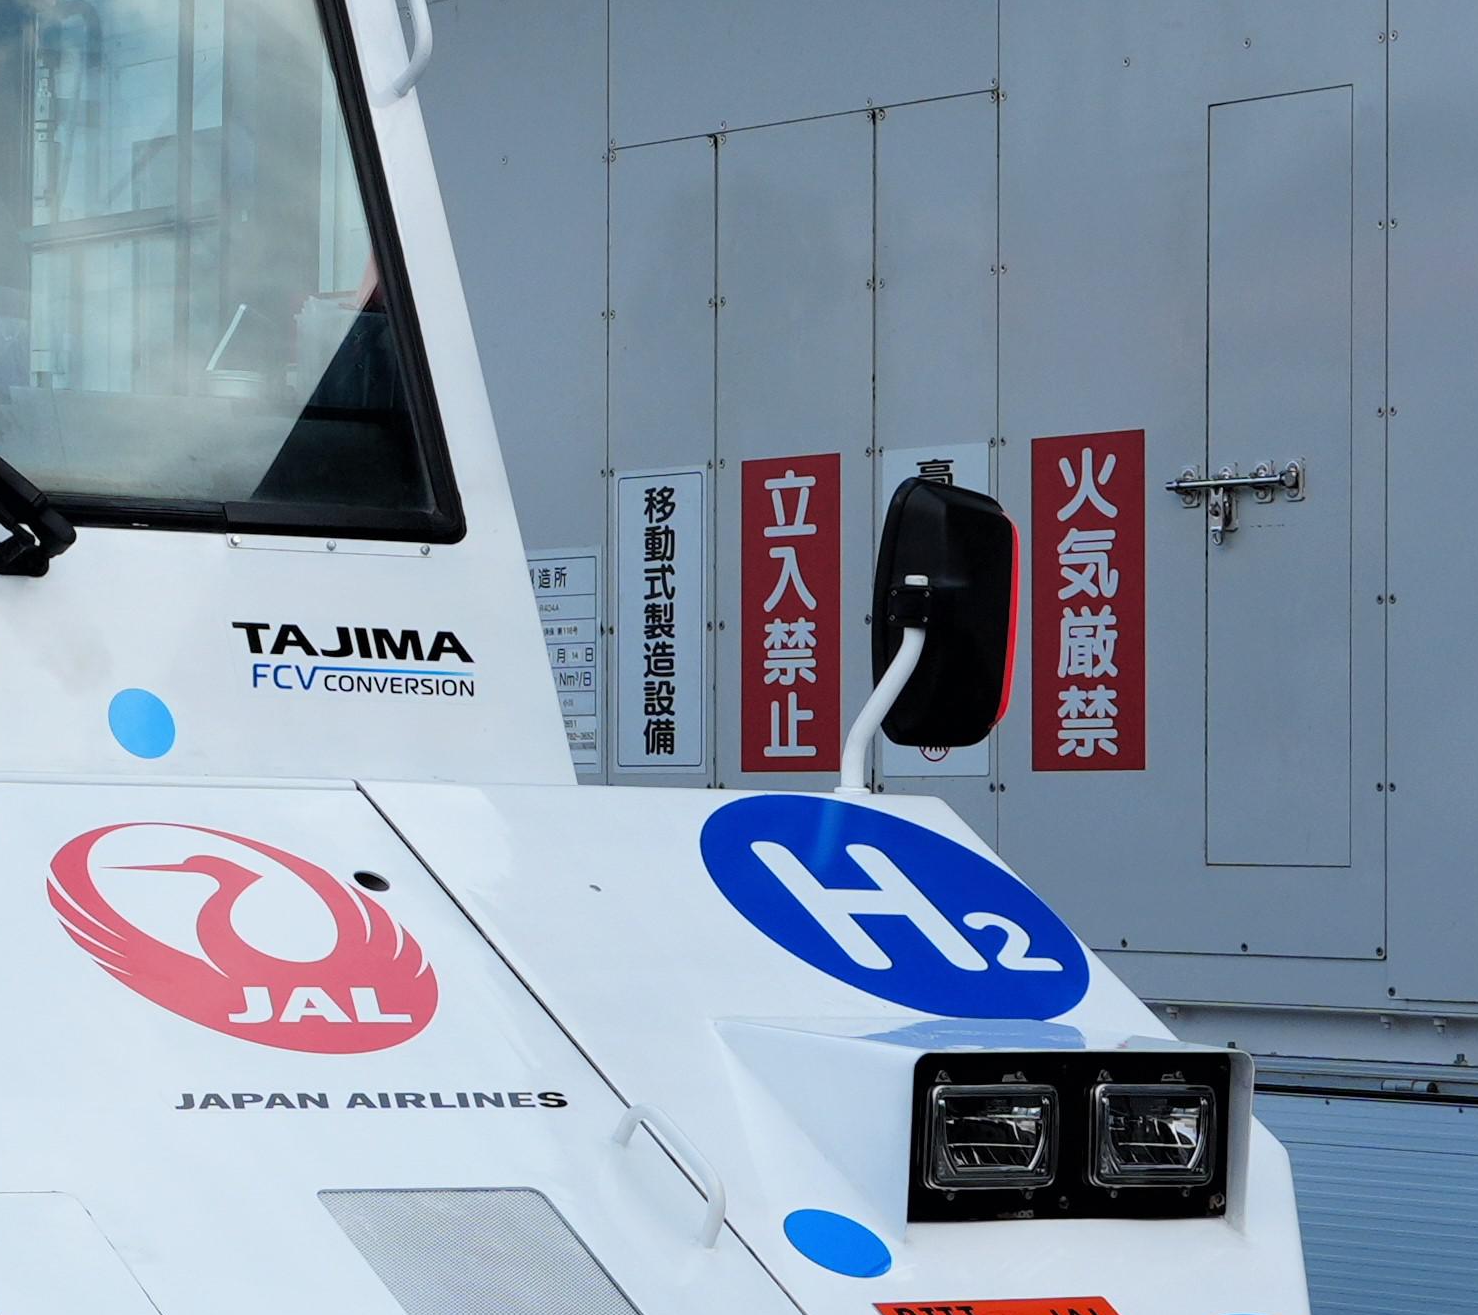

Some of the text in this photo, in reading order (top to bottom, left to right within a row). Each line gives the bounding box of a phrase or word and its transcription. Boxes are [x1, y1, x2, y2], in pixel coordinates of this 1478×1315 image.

[231, 622, 475, 663] TAJIMA
[643, 485, 676, 757] 移動式製造設備
[763, 469, 817, 758] 立入禁止
[1056, 446, 1119, 758] 火気厳禁
[253, 663, 475, 697] FCV CONVERSION
[750, 840, 1063, 972] H2
[228, 985, 413, 1026] JAL
[174, 1091, 569, 1110] JAPAN AIRLINES
